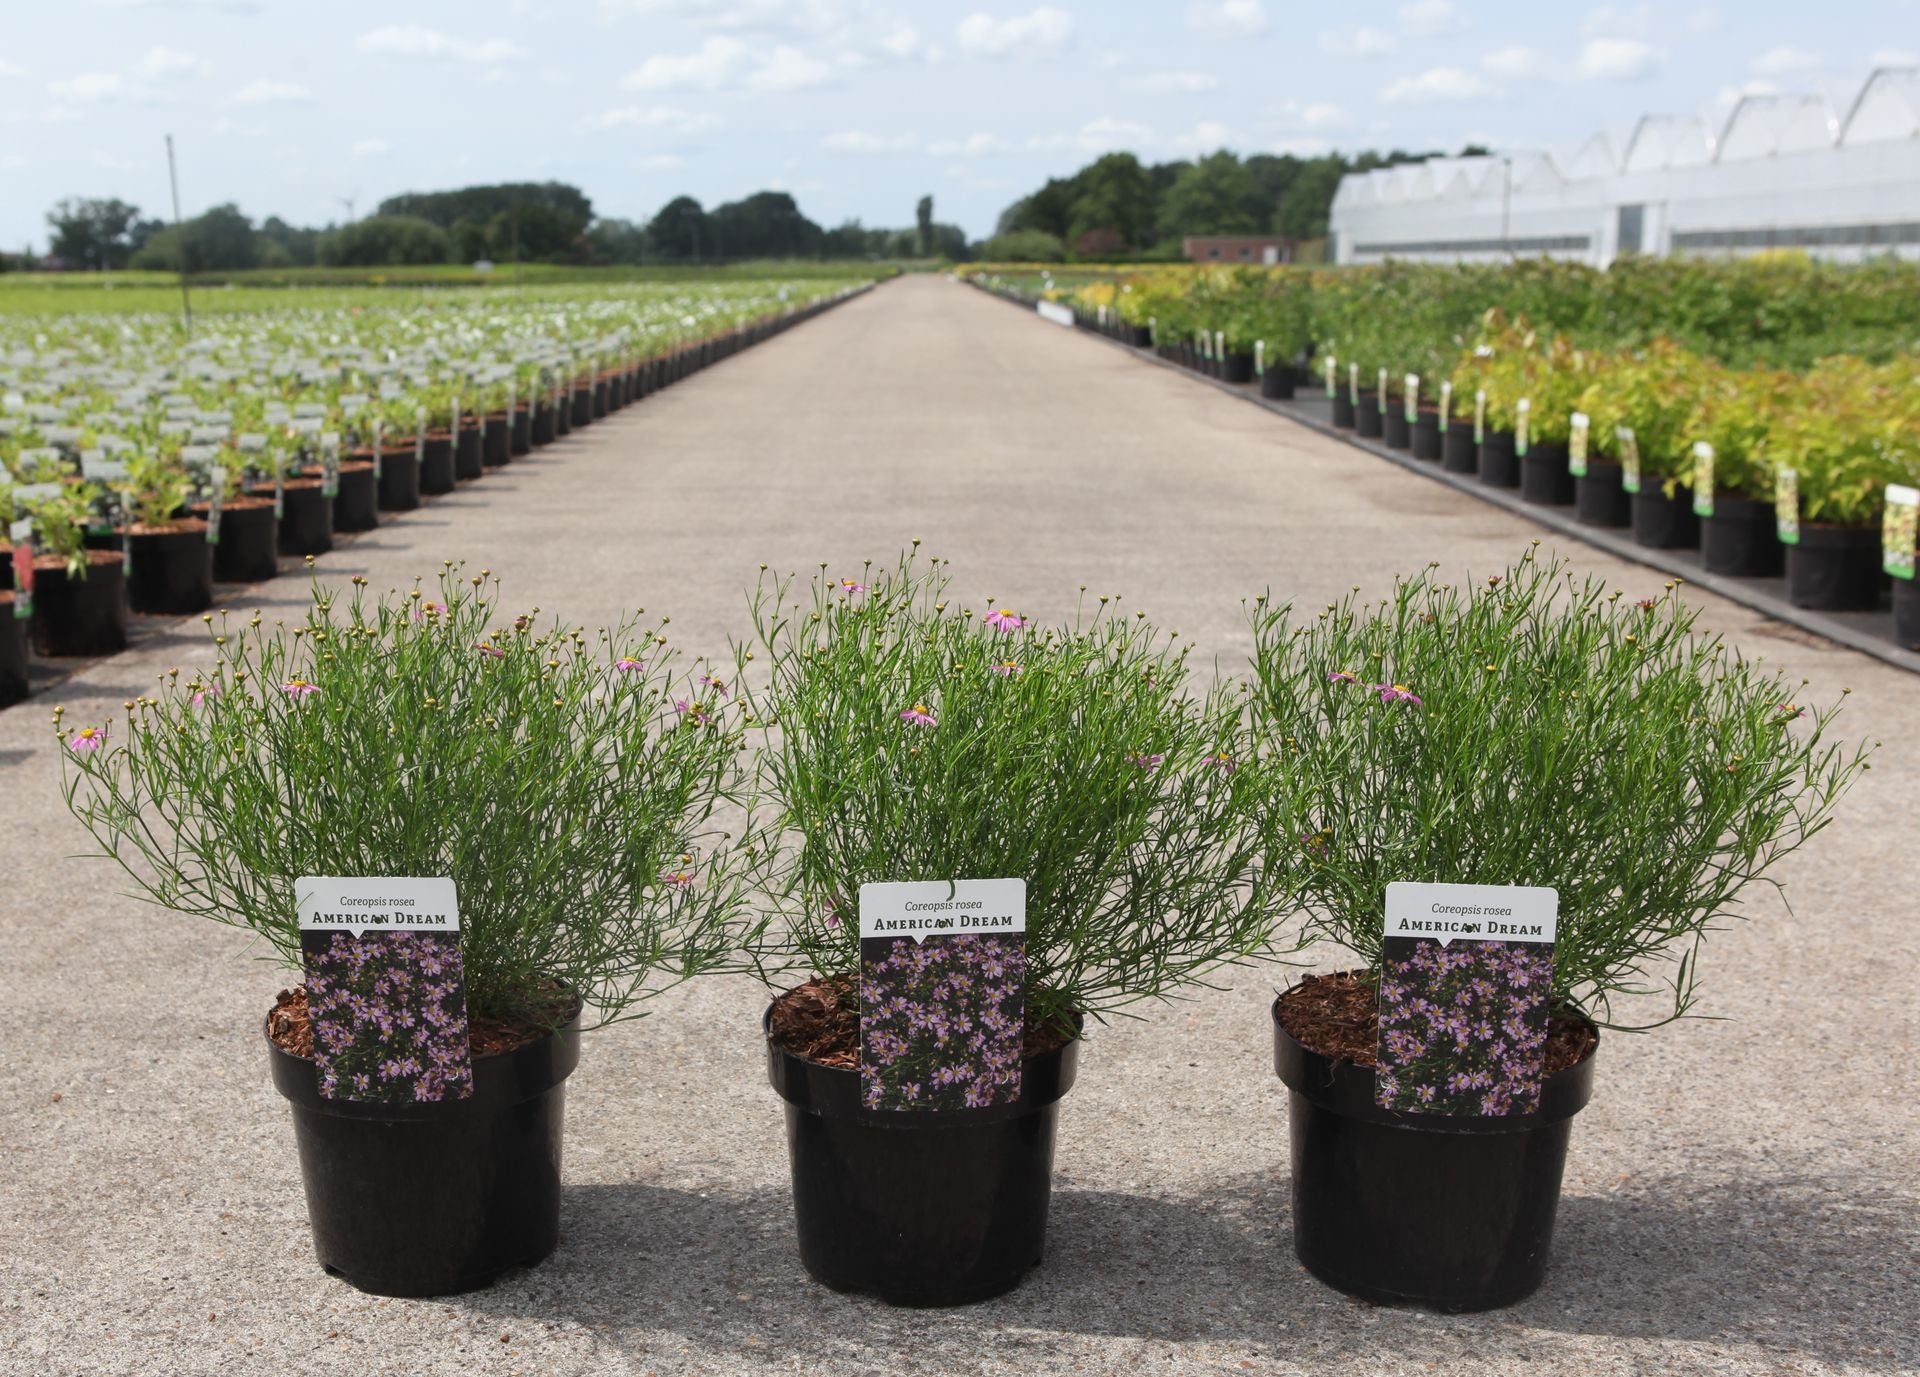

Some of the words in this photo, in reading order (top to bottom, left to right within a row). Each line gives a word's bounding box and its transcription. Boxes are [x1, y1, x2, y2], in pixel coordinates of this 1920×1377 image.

[340, 896, 387, 908] Coreopsis
[389, 898, 415, 906] rosea
[905, 901, 953, 912] Coreopsis
[955, 901, 982, 910] rosea
[1431, 903, 1481, 916] Coreopsis
[1483, 907, 1512, 916] rosea
[312, 911, 389, 924] AMERICAN
[395, 912, 446, 924] DREAM
[874, 918, 954, 930] AMERICAN
[960, 915, 1013, 927] DREAM
[1398, 918, 1481, 933] AMERICAN
[1488, 921, 1542, 935] DREAM
